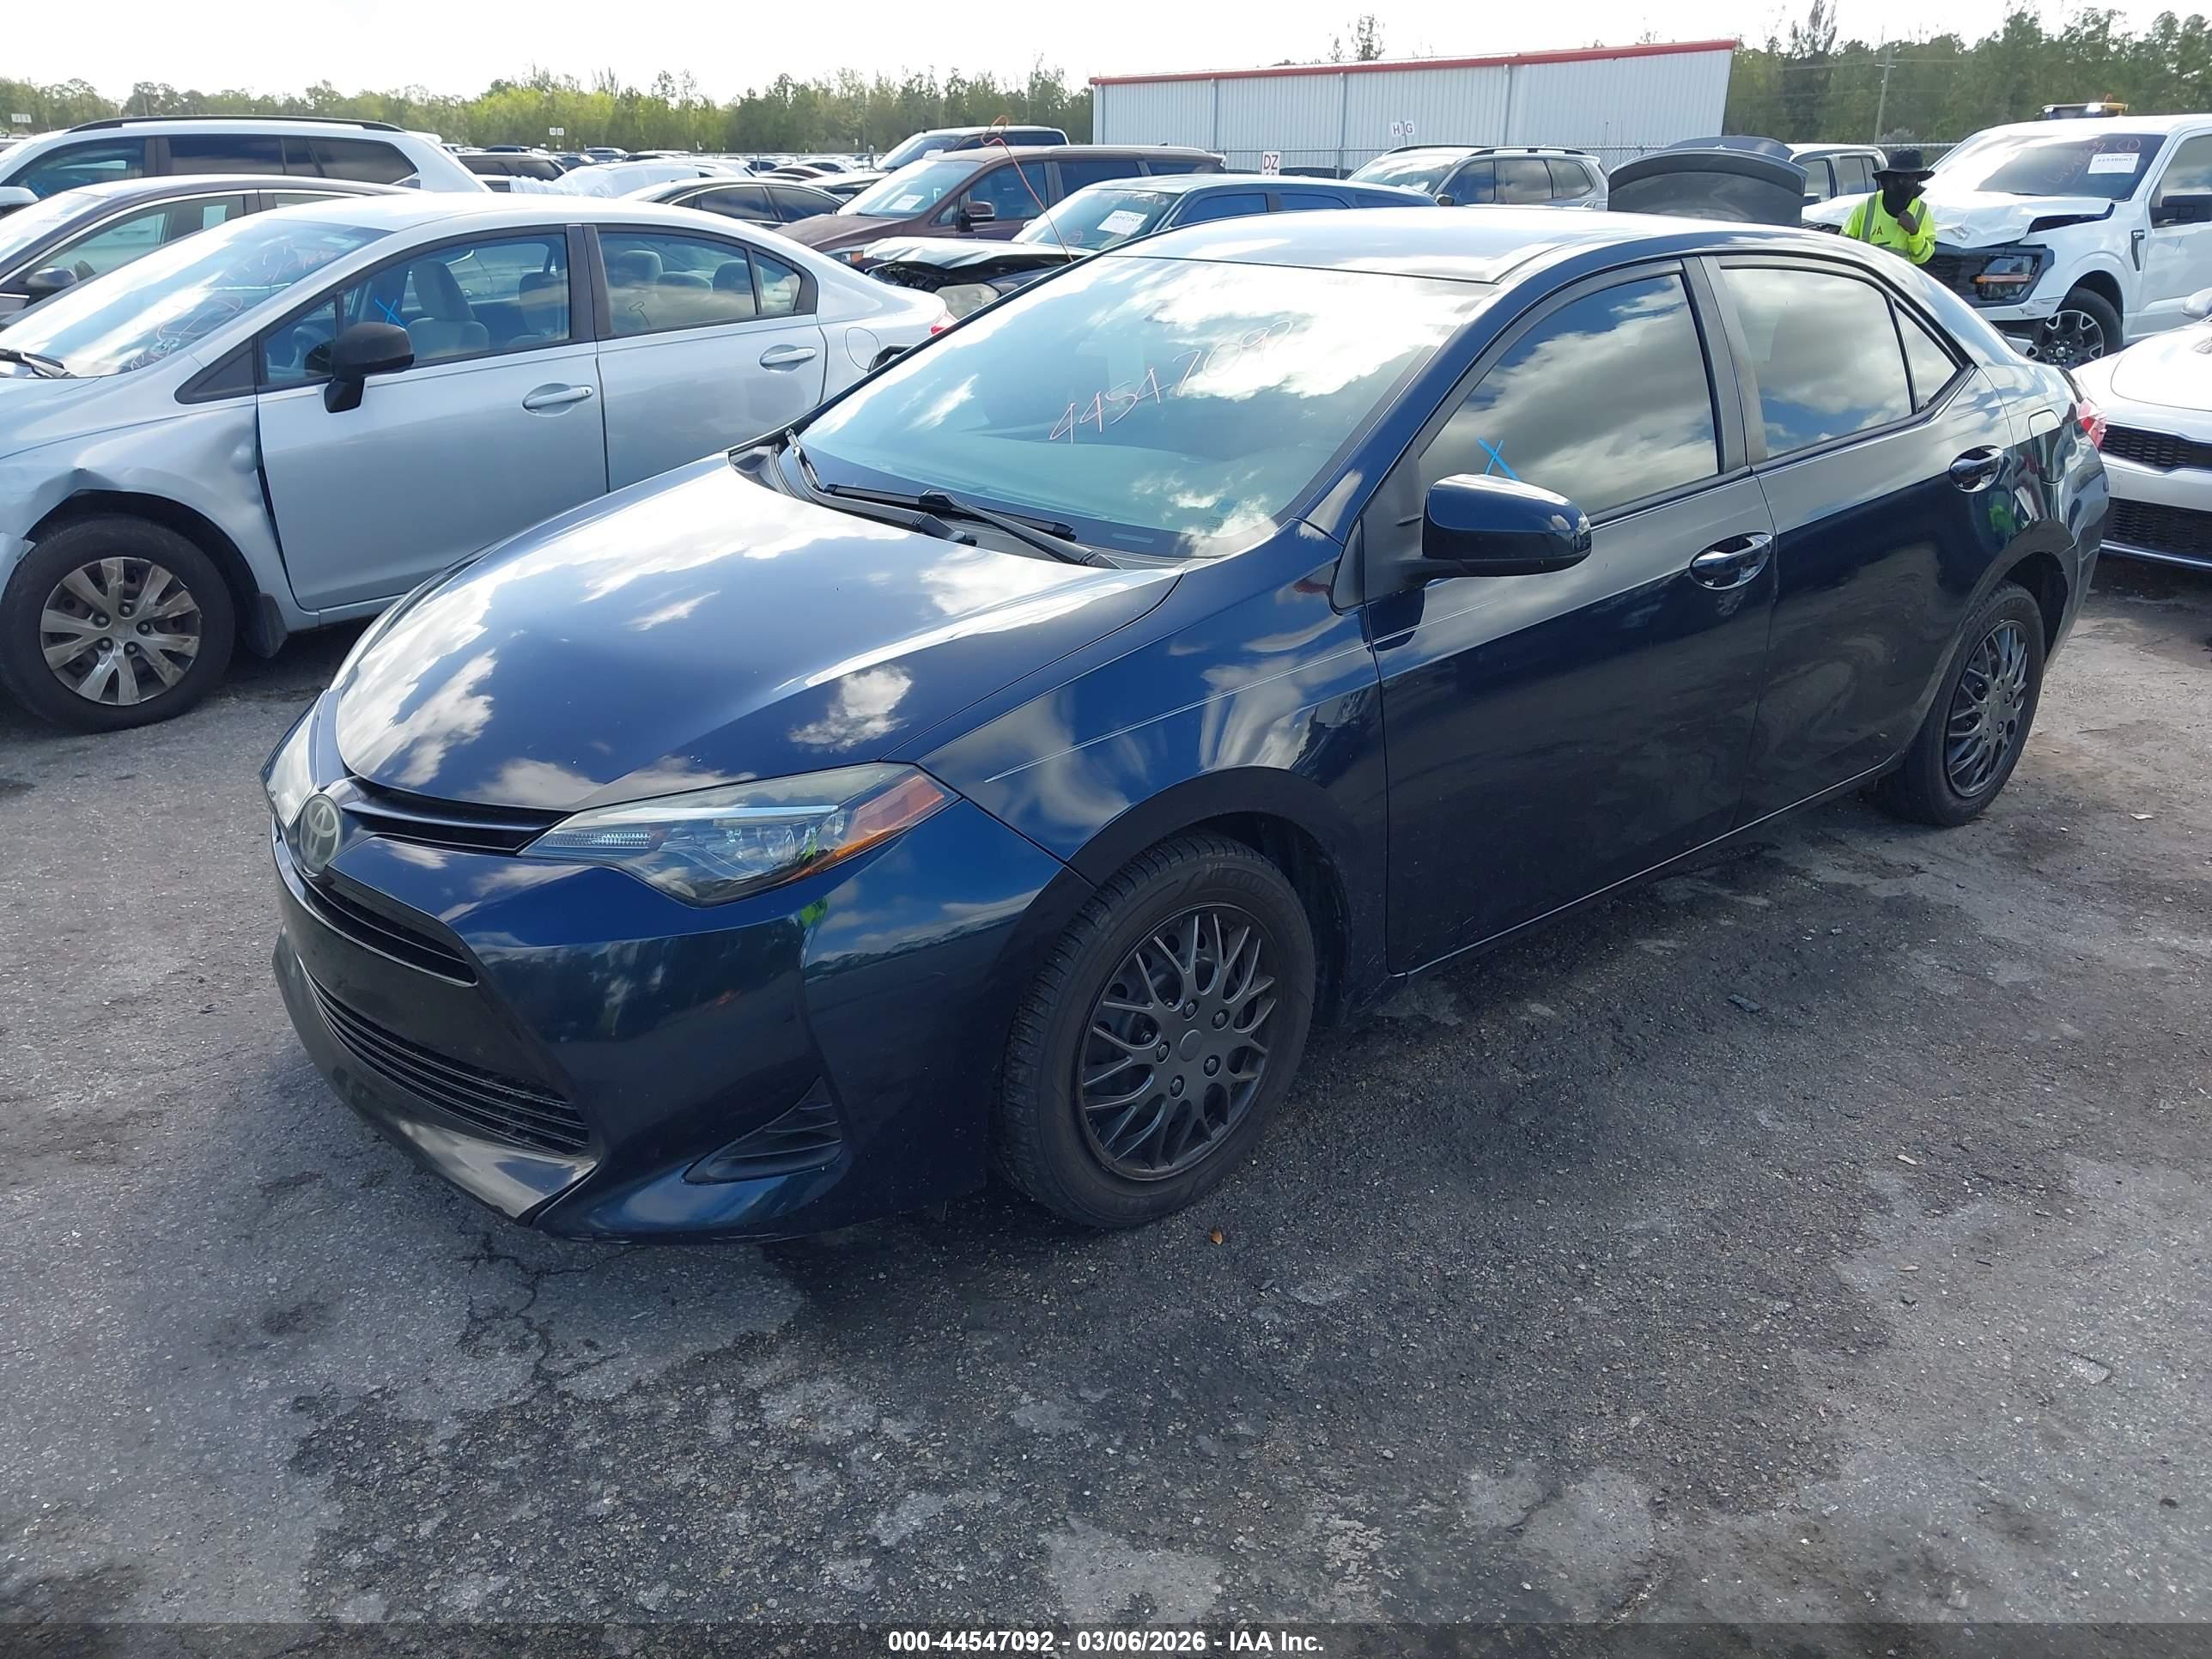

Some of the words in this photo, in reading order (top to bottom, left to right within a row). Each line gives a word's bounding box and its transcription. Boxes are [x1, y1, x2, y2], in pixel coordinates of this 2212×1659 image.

[1393, 124, 1401, 135] H
[1405, 123, 1413, 134] G
[1263, 154, 1279, 170] DZ
